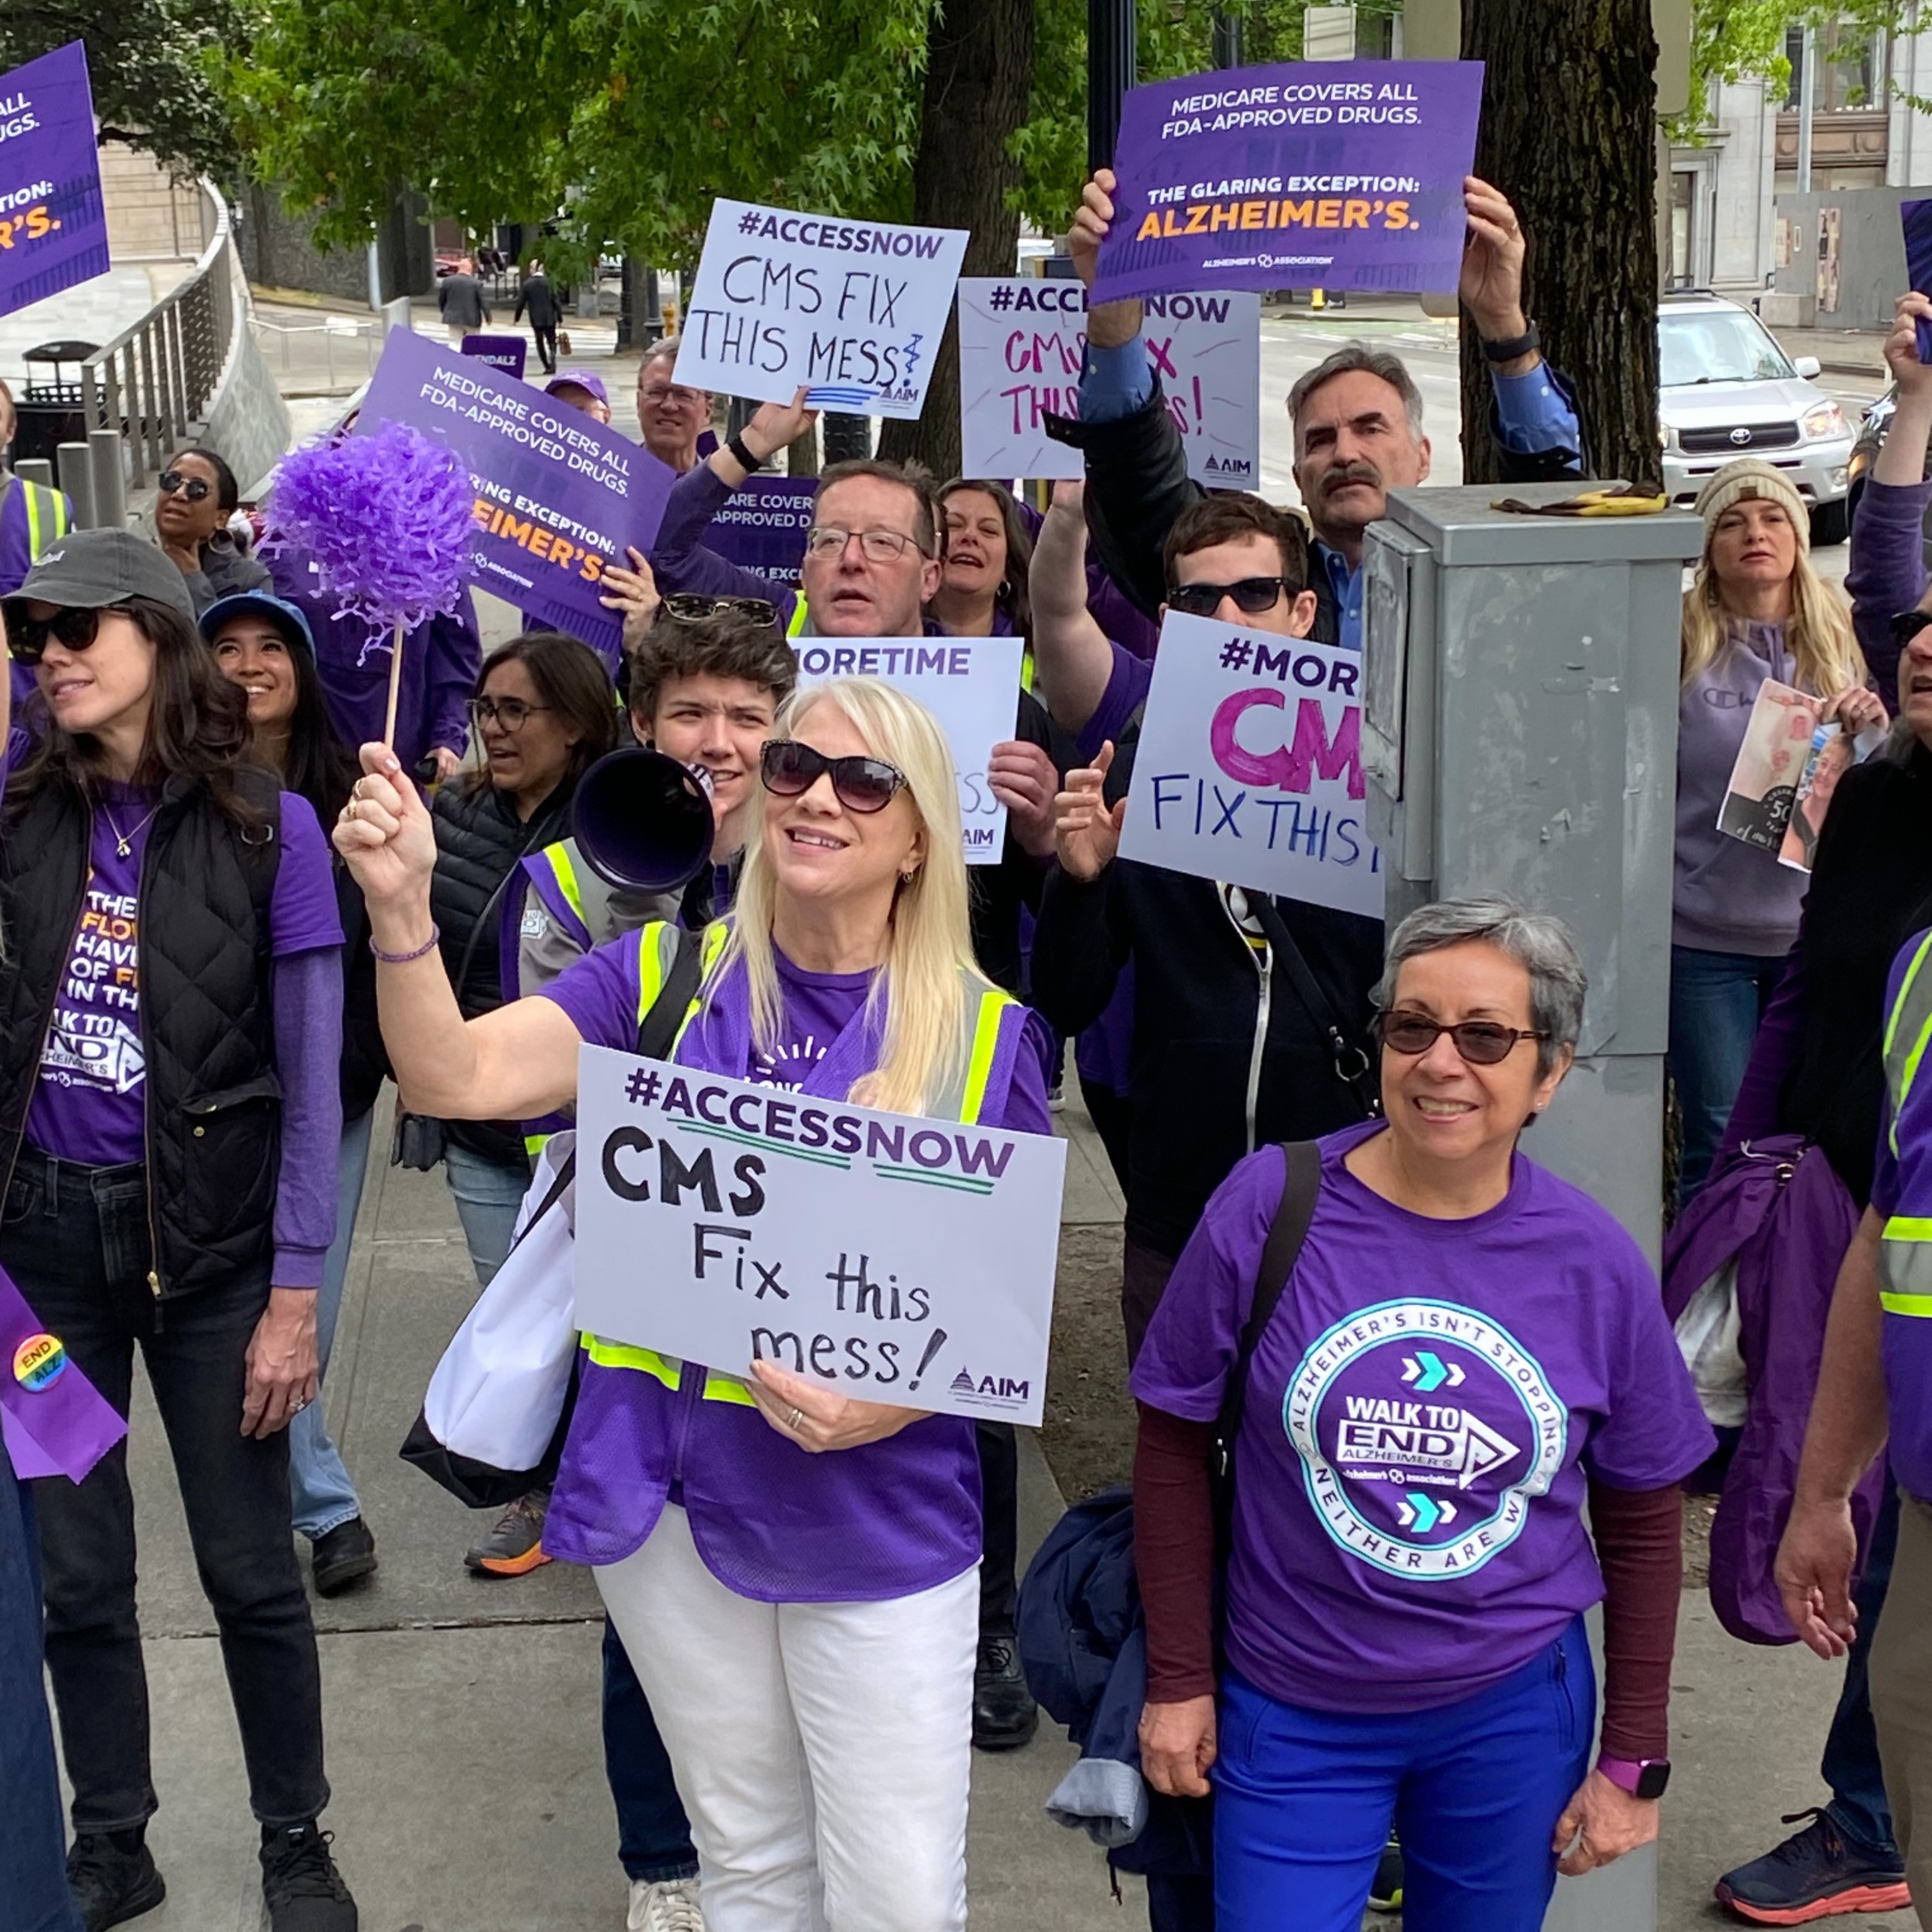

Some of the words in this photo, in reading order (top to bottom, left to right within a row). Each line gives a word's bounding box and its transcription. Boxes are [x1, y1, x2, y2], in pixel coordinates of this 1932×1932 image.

[1171, 85, 1279, 116] MEDICARE
[1283, 83, 1373, 103] COVERS
[1377, 83, 1418, 102] ALL
[1161, 107, 1332, 140] FDA-APPROVED
[1337, 106, 1422, 125] DRUGS.
[1148, 185, 1186, 205] THE
[1191, 176, 1282, 198] GLARING
[1287, 176, 1420, 193] EXCEPTION:
[737, 210, 945, 260] #ACCESSNOW
[1136, 199, 1420, 242] ALZHEIMER'S.
[723, 255, 822, 314] CMS
[837, 271, 908, 328] FIX
[691, 309, 789, 373] THIS
[892, 387, 919, 402] AIM
[433, 366, 529, 421] MEDICARE
[531, 411, 600, 457] COVERS
[600, 450, 630, 476] ALL
[419, 383, 566, 461] FDA-APPROVED
[567, 452, 629, 498] DRUGS.
[1221, 457, 1250, 474] AIM
[514, 495, 616, 555] EXCEPTION:
[1211, 687, 1365, 800] CM
[1151, 773, 1245, 838] FIX
[1255, 800, 1360, 867] THIS
[87, 891, 137, 918] THE
[81, 912, 138, 940] FLO
[70, 958, 109, 980] OF
[67, 979, 95, 1002] IN
[83, 1014, 114, 1037] TO
[48, 1030, 108, 1061] ND
[624, 1068, 1015, 1179] #ACCESSNOW
[601, 1125, 766, 1217] CMS
[694, 1223, 790, 1300] Fix
[825, 1252, 931, 1322] this
[22, 1341, 51, 1369] END
[35, 1356, 61, 1383] ALZ
[751, 1327, 947, 1391] mess!
[977, 1375, 1029, 1399] AIM
[1293, 1312, 1406, 1432] ALZHEIMER'S
[1419, 1312, 1486, 1342] ISN'T
[1491, 1342, 1557, 1459] STOPPING
[1346, 1396, 1422, 1426] WALK
[1425, 1406, 1459, 1430] TO
[1345, 1424, 1455, 1456] END
[1342, 1449, 1453, 1468] ALZHEIMER'S
[1317, 1468, 1422, 1568] NEITHER
[1444, 1531, 1494, 1568] ARE
